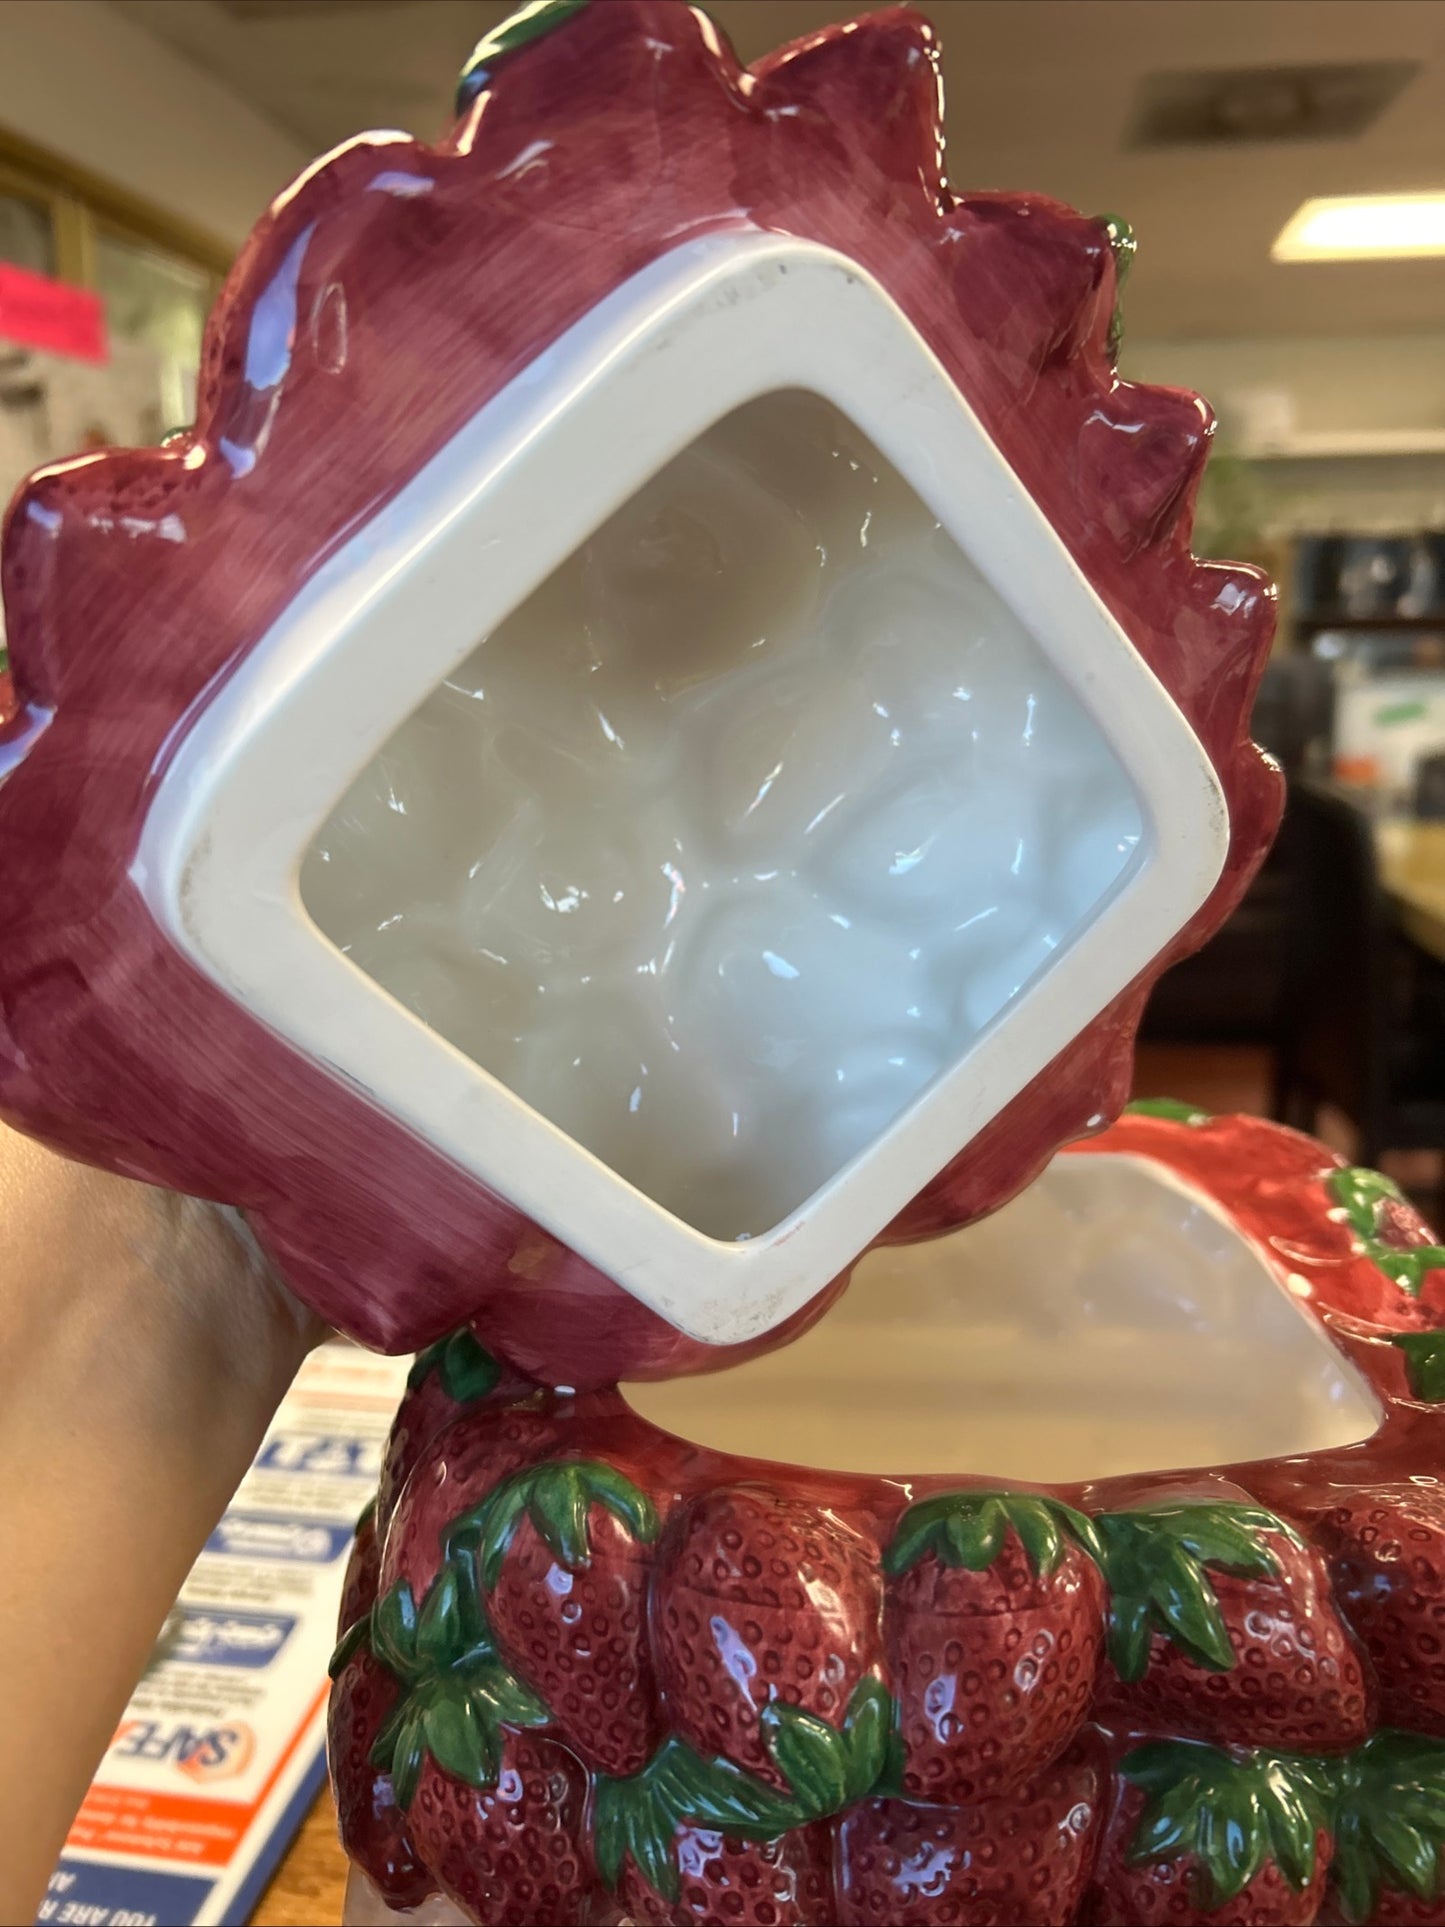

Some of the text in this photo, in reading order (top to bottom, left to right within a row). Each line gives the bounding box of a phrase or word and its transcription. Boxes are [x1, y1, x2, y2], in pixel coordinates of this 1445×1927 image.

[115, 1719, 239, 1767] SAFE
[57, 1902, 110, 1926] ARE
[108, 1909, 156, 1926] YOU
